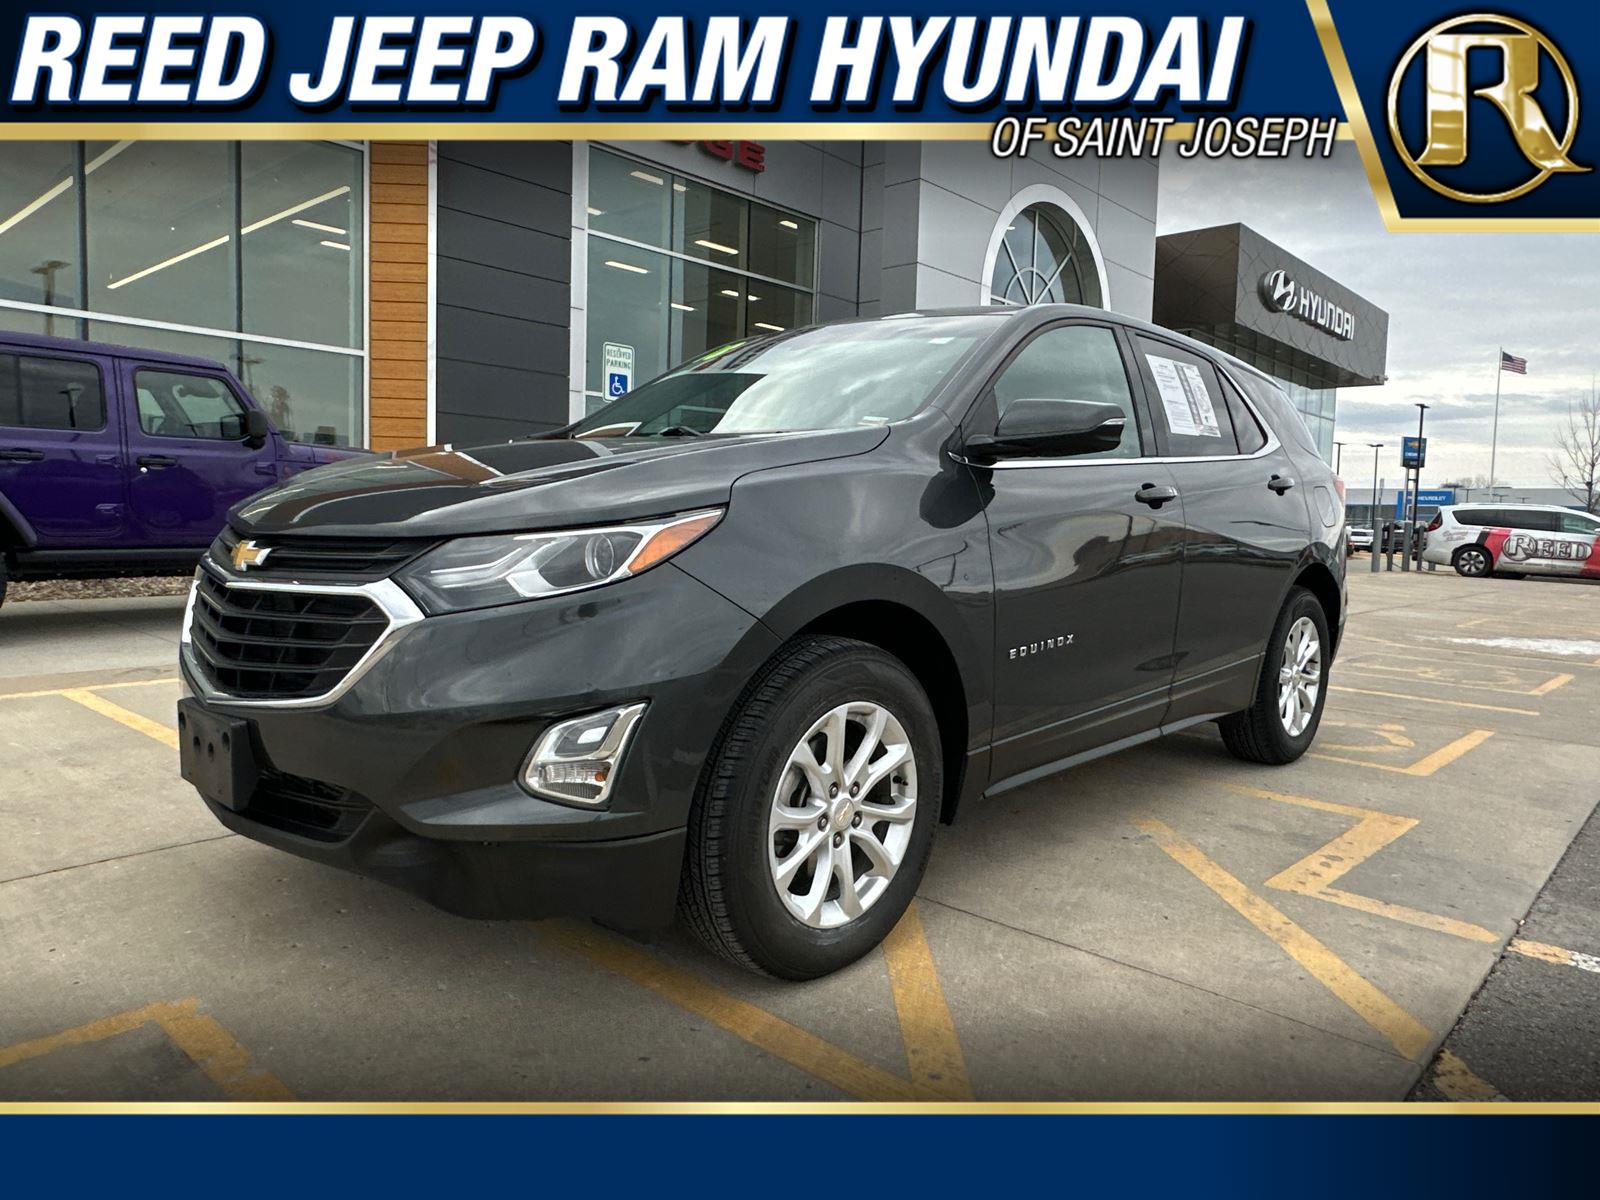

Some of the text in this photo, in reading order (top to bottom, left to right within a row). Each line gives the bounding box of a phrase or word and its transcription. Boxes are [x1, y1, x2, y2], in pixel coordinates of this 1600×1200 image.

[1299, 286, 1355, 340] HYUNDAI
[606, 359, 631, 370] PARKING
[1506, 533, 1592, 560] REED
[1009, 633, 1075, 660] EQUINOX
